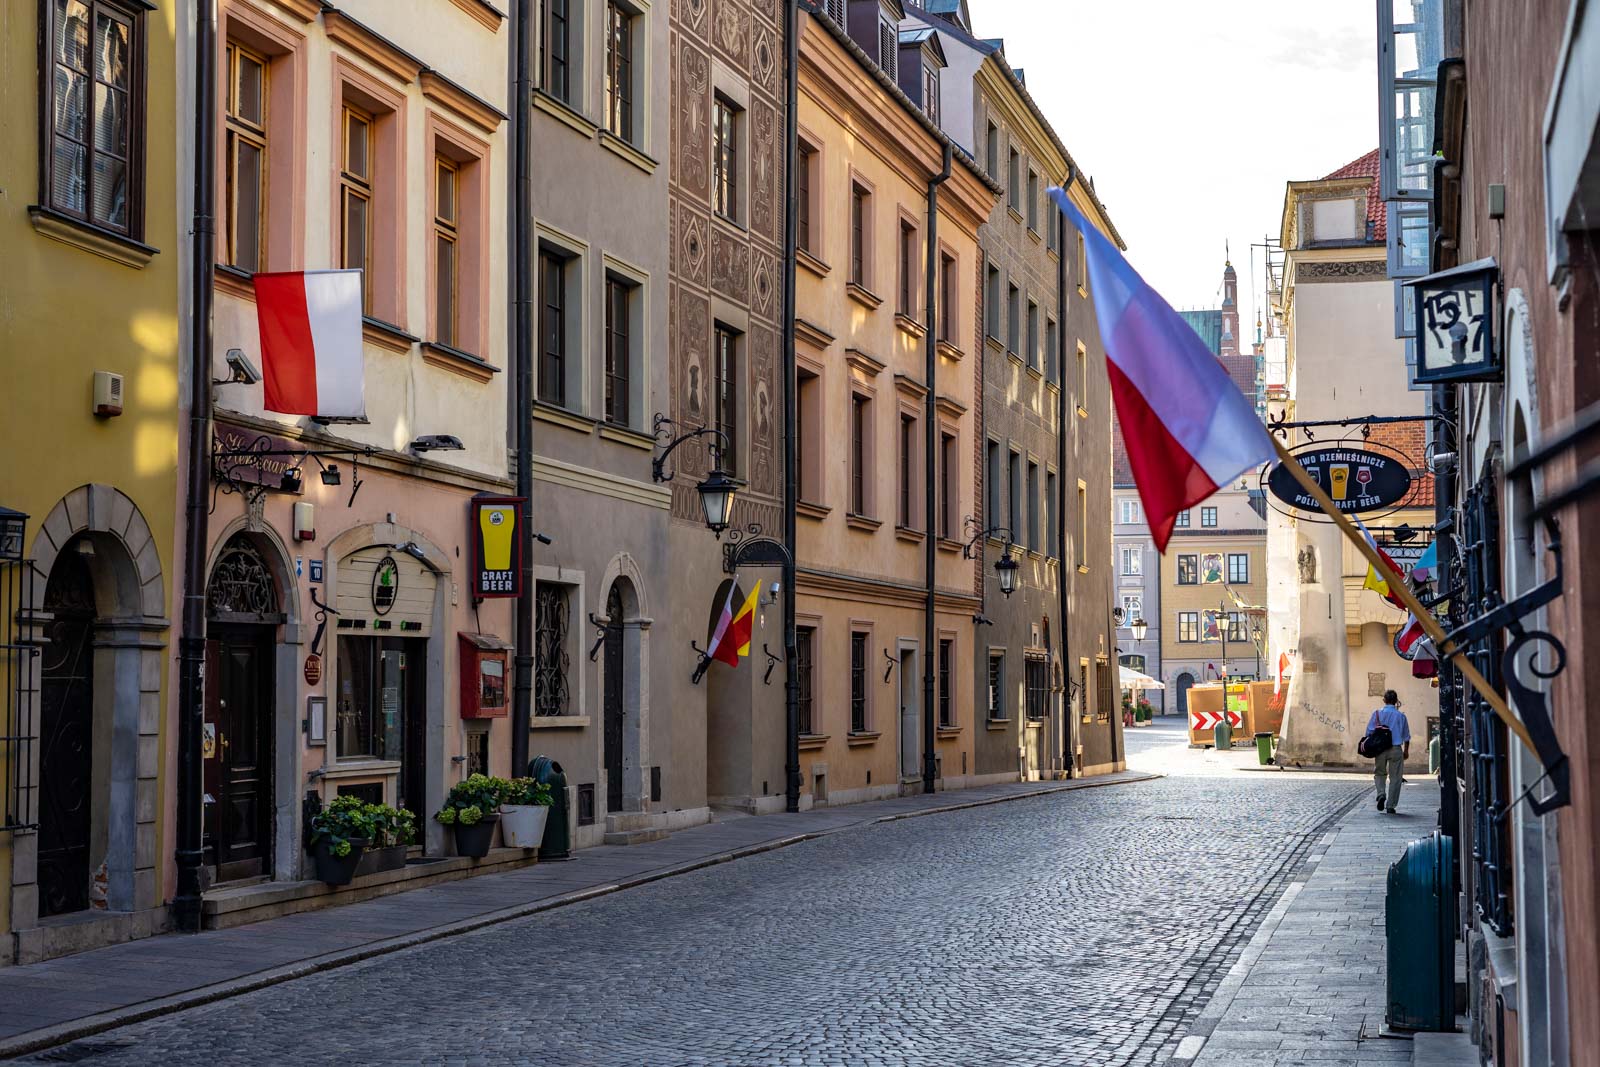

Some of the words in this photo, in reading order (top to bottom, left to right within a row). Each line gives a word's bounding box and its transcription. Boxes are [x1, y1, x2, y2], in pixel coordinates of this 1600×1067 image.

[1296, 455, 1316, 467] IWO
[1320, 453, 1386, 468] RZEMIEŚLNICZE
[1295, 494, 1322, 508] POLIS
[1332, 500, 1357, 509] RAFT
[1360, 495, 1381, 507] BEER
[313, 567, 321, 579] 10
[482, 571, 513, 581] CRAFT
[482, 580, 513, 591] BEER
